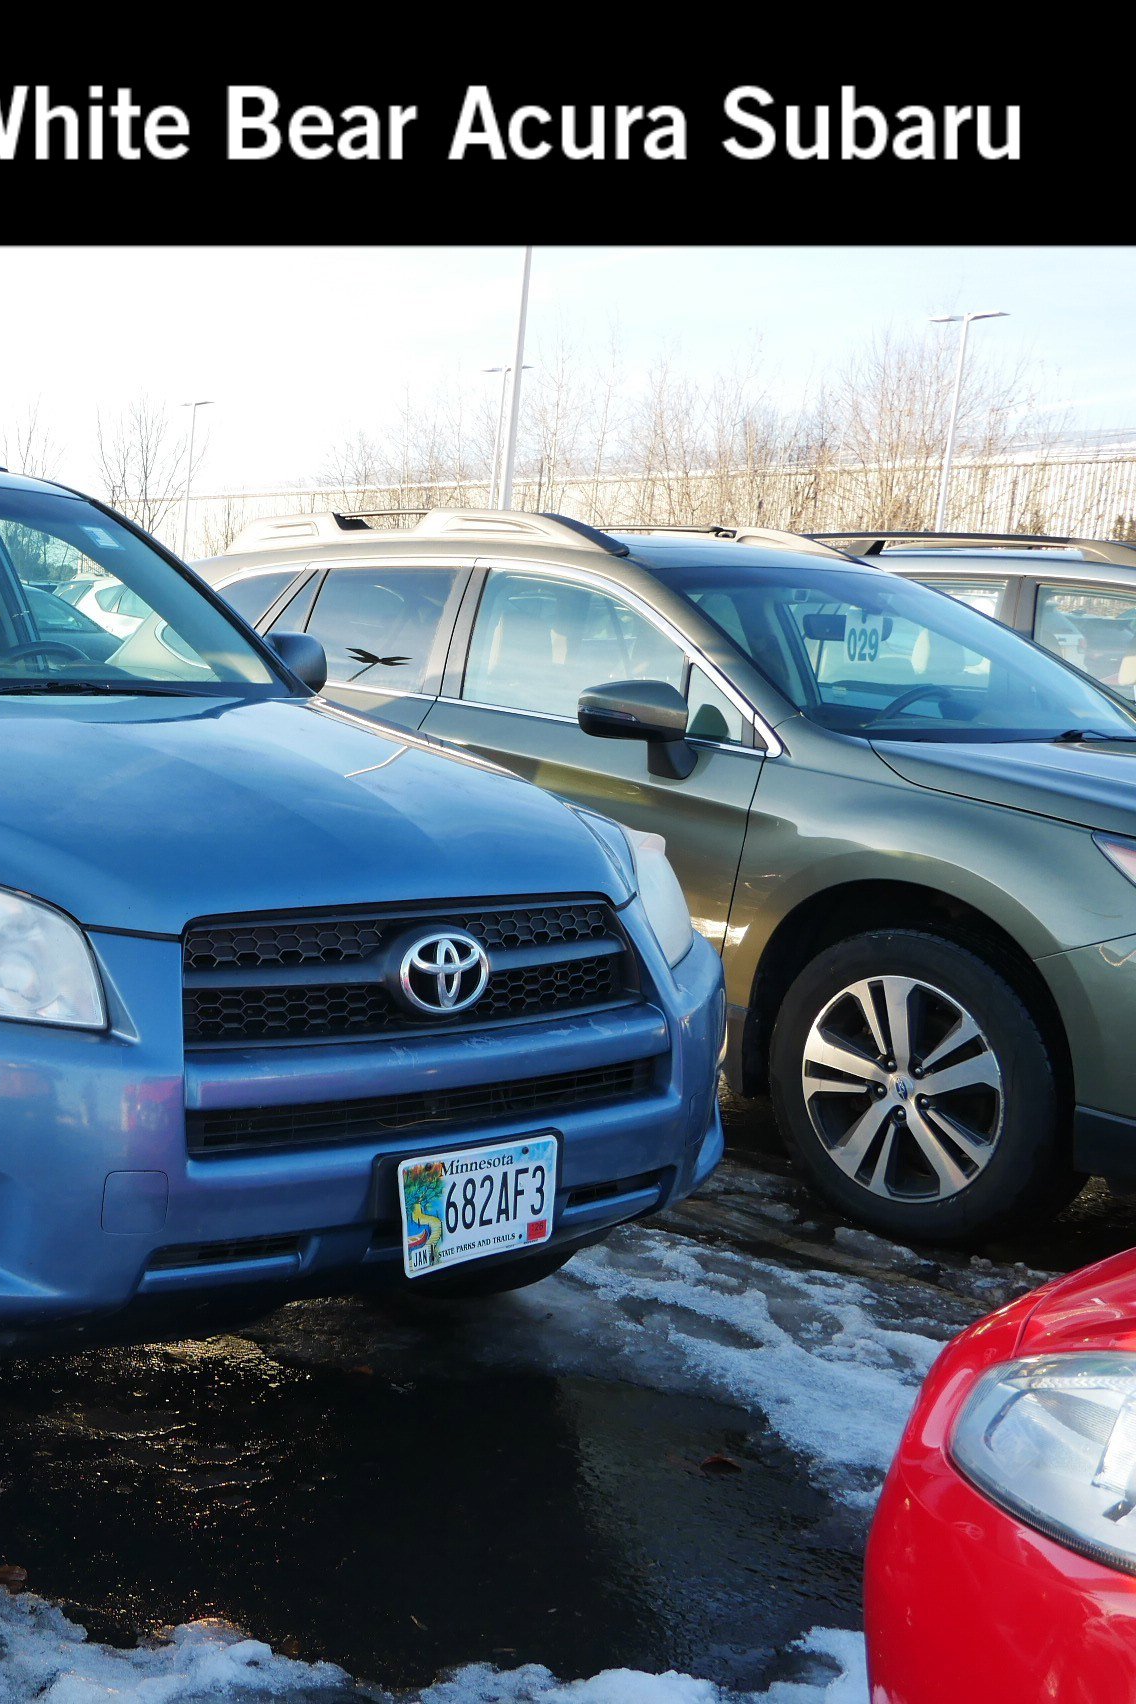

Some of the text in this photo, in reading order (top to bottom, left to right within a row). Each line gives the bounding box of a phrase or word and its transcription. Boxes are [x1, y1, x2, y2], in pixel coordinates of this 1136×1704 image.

[847, 627, 879, 662] 029
[439, 1154, 514, 1178] Minnesota
[444, 1165, 546, 1234] 682AF3
[413, 1249, 428, 1268] JAN
[438, 1248, 455, 1259] STATE
[456, 1243, 476, 1253] PARKS
[477, 1239, 491, 1248] AND
[493, 1233, 516, 1243] TRAILS
